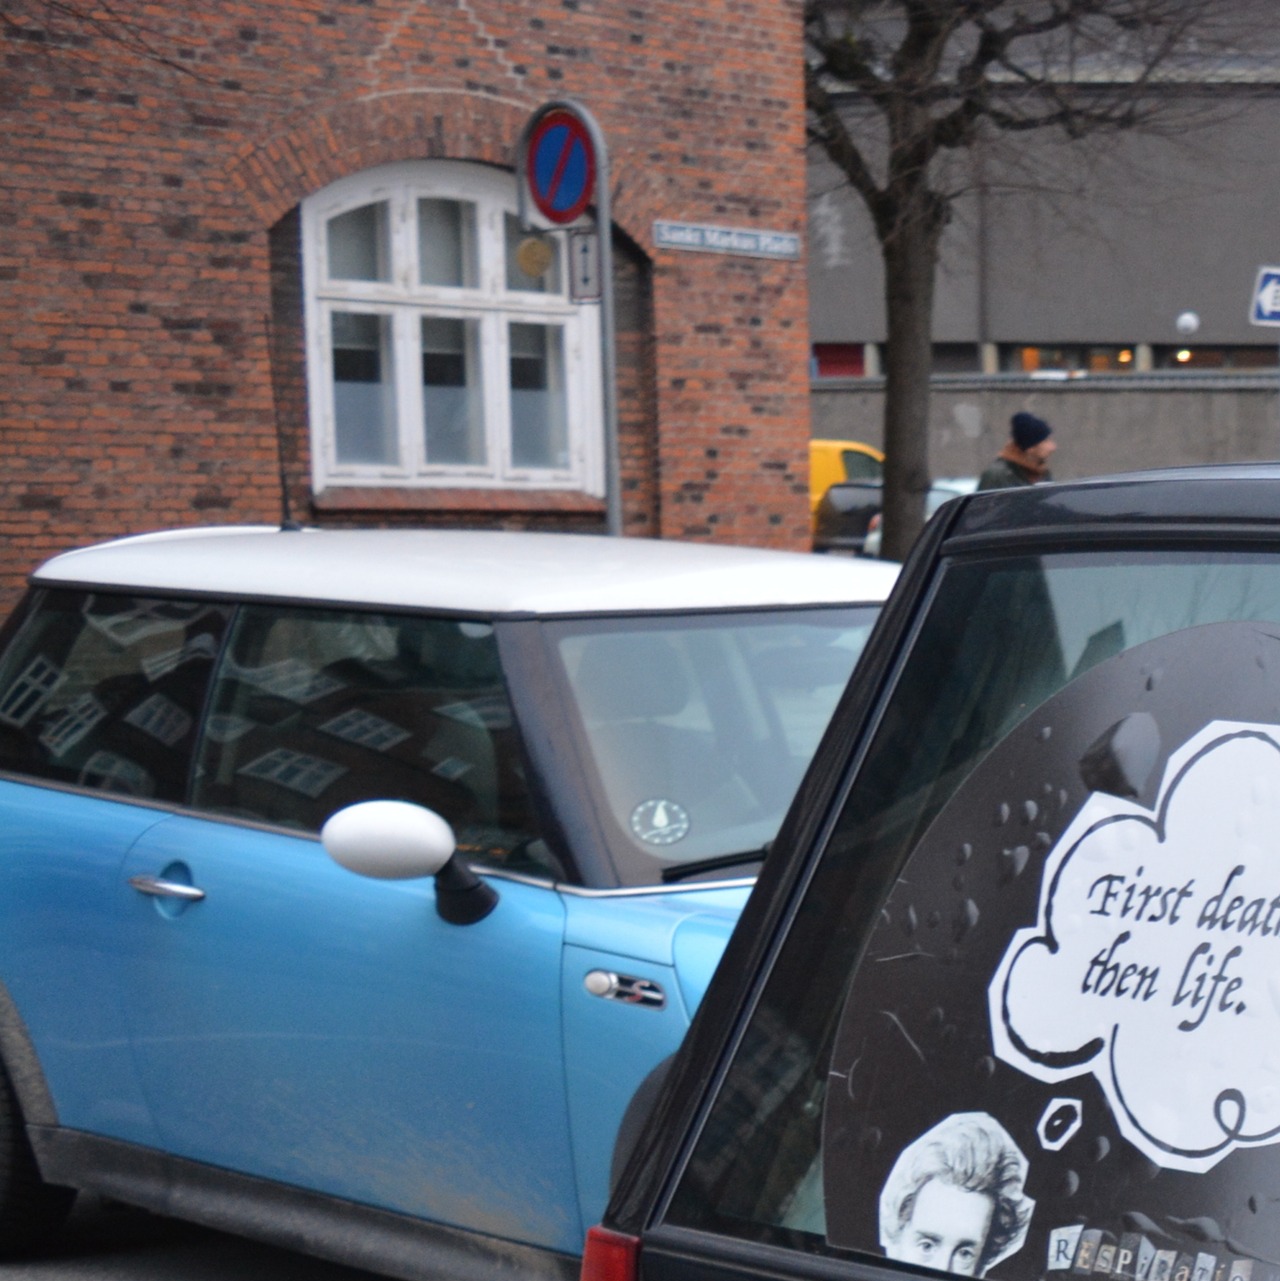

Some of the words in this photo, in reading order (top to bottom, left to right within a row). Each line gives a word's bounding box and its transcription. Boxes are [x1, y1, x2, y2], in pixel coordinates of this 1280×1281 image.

[1086, 865, 1196, 926] First
[1080, 930, 1161, 1002] then
[1171, 941, 1247, 1032] life.
